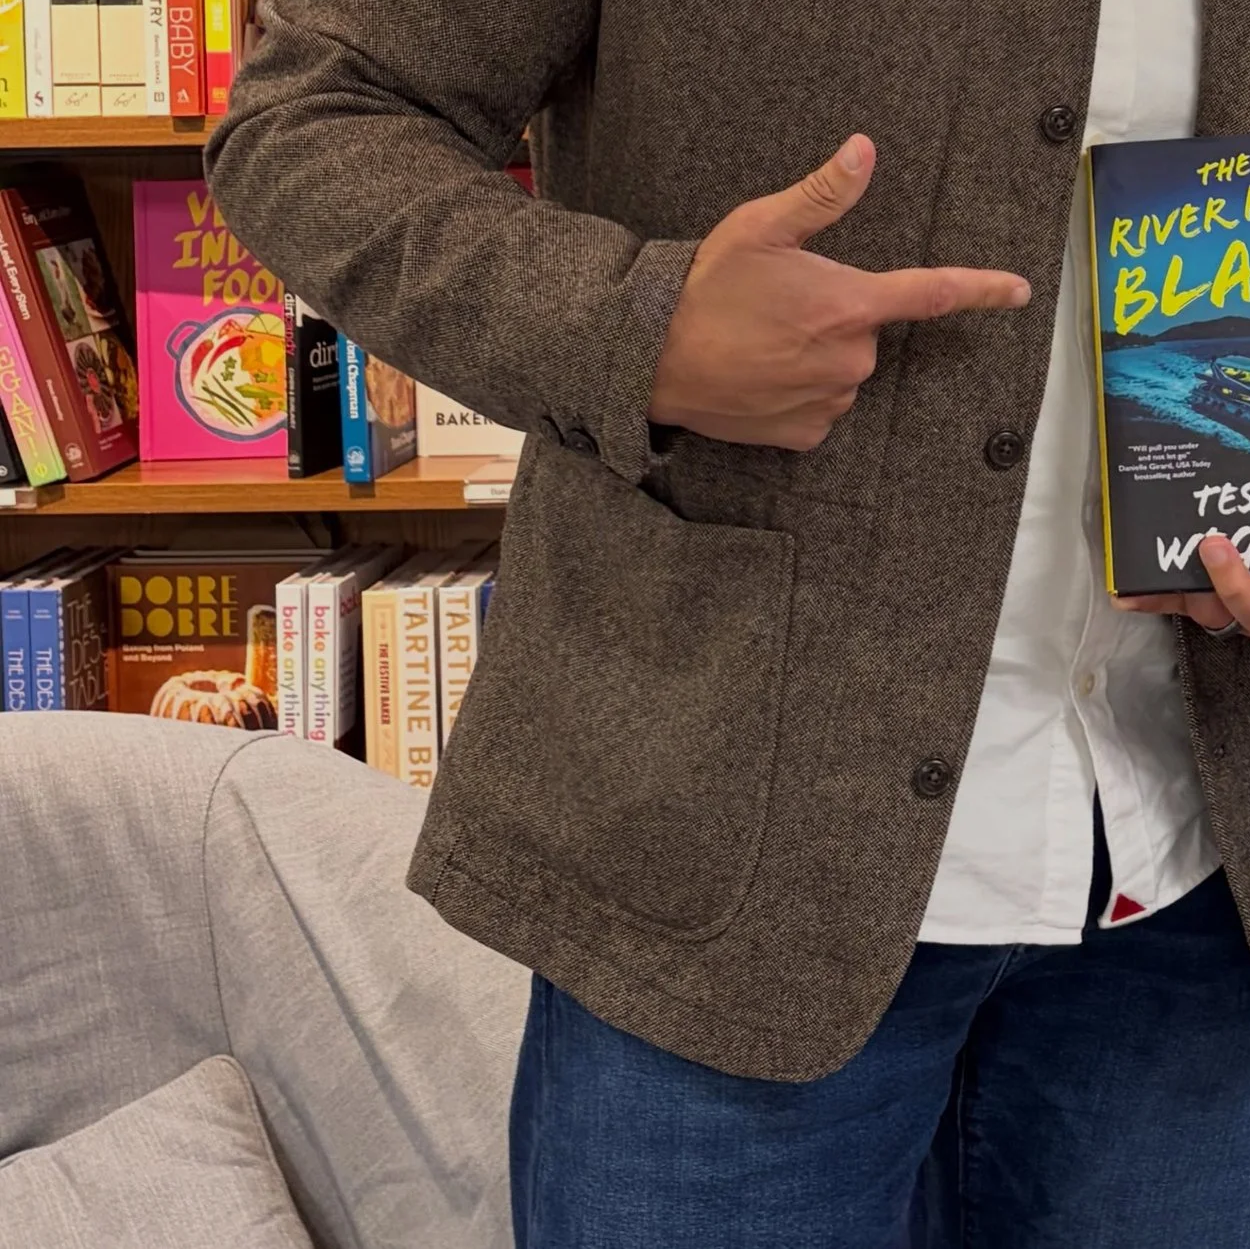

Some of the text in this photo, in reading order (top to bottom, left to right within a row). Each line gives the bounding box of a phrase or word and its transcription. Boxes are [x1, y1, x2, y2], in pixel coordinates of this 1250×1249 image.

[169, 7, 195, 76] BABY
[1109, 196, 1240, 259] RIVER
[348, 365, 359, 419] Chapman
[1118, 461, 1190, 472] Danielle USA
[1134, 470, 1196, 481] bestselling author
[120, 576, 239, 604] DOBRE
[121, 608, 239, 637] DOBRE
[282, 606, 299, 652] bake
[8, 649, 24, 675] THE
[36, 648, 52, 675] THE
[308, 606, 331, 741] bake anything
[379, 643, 390, 725] THE FESTIVE BAKER
[404, 593, 431, 732] TARTINE
